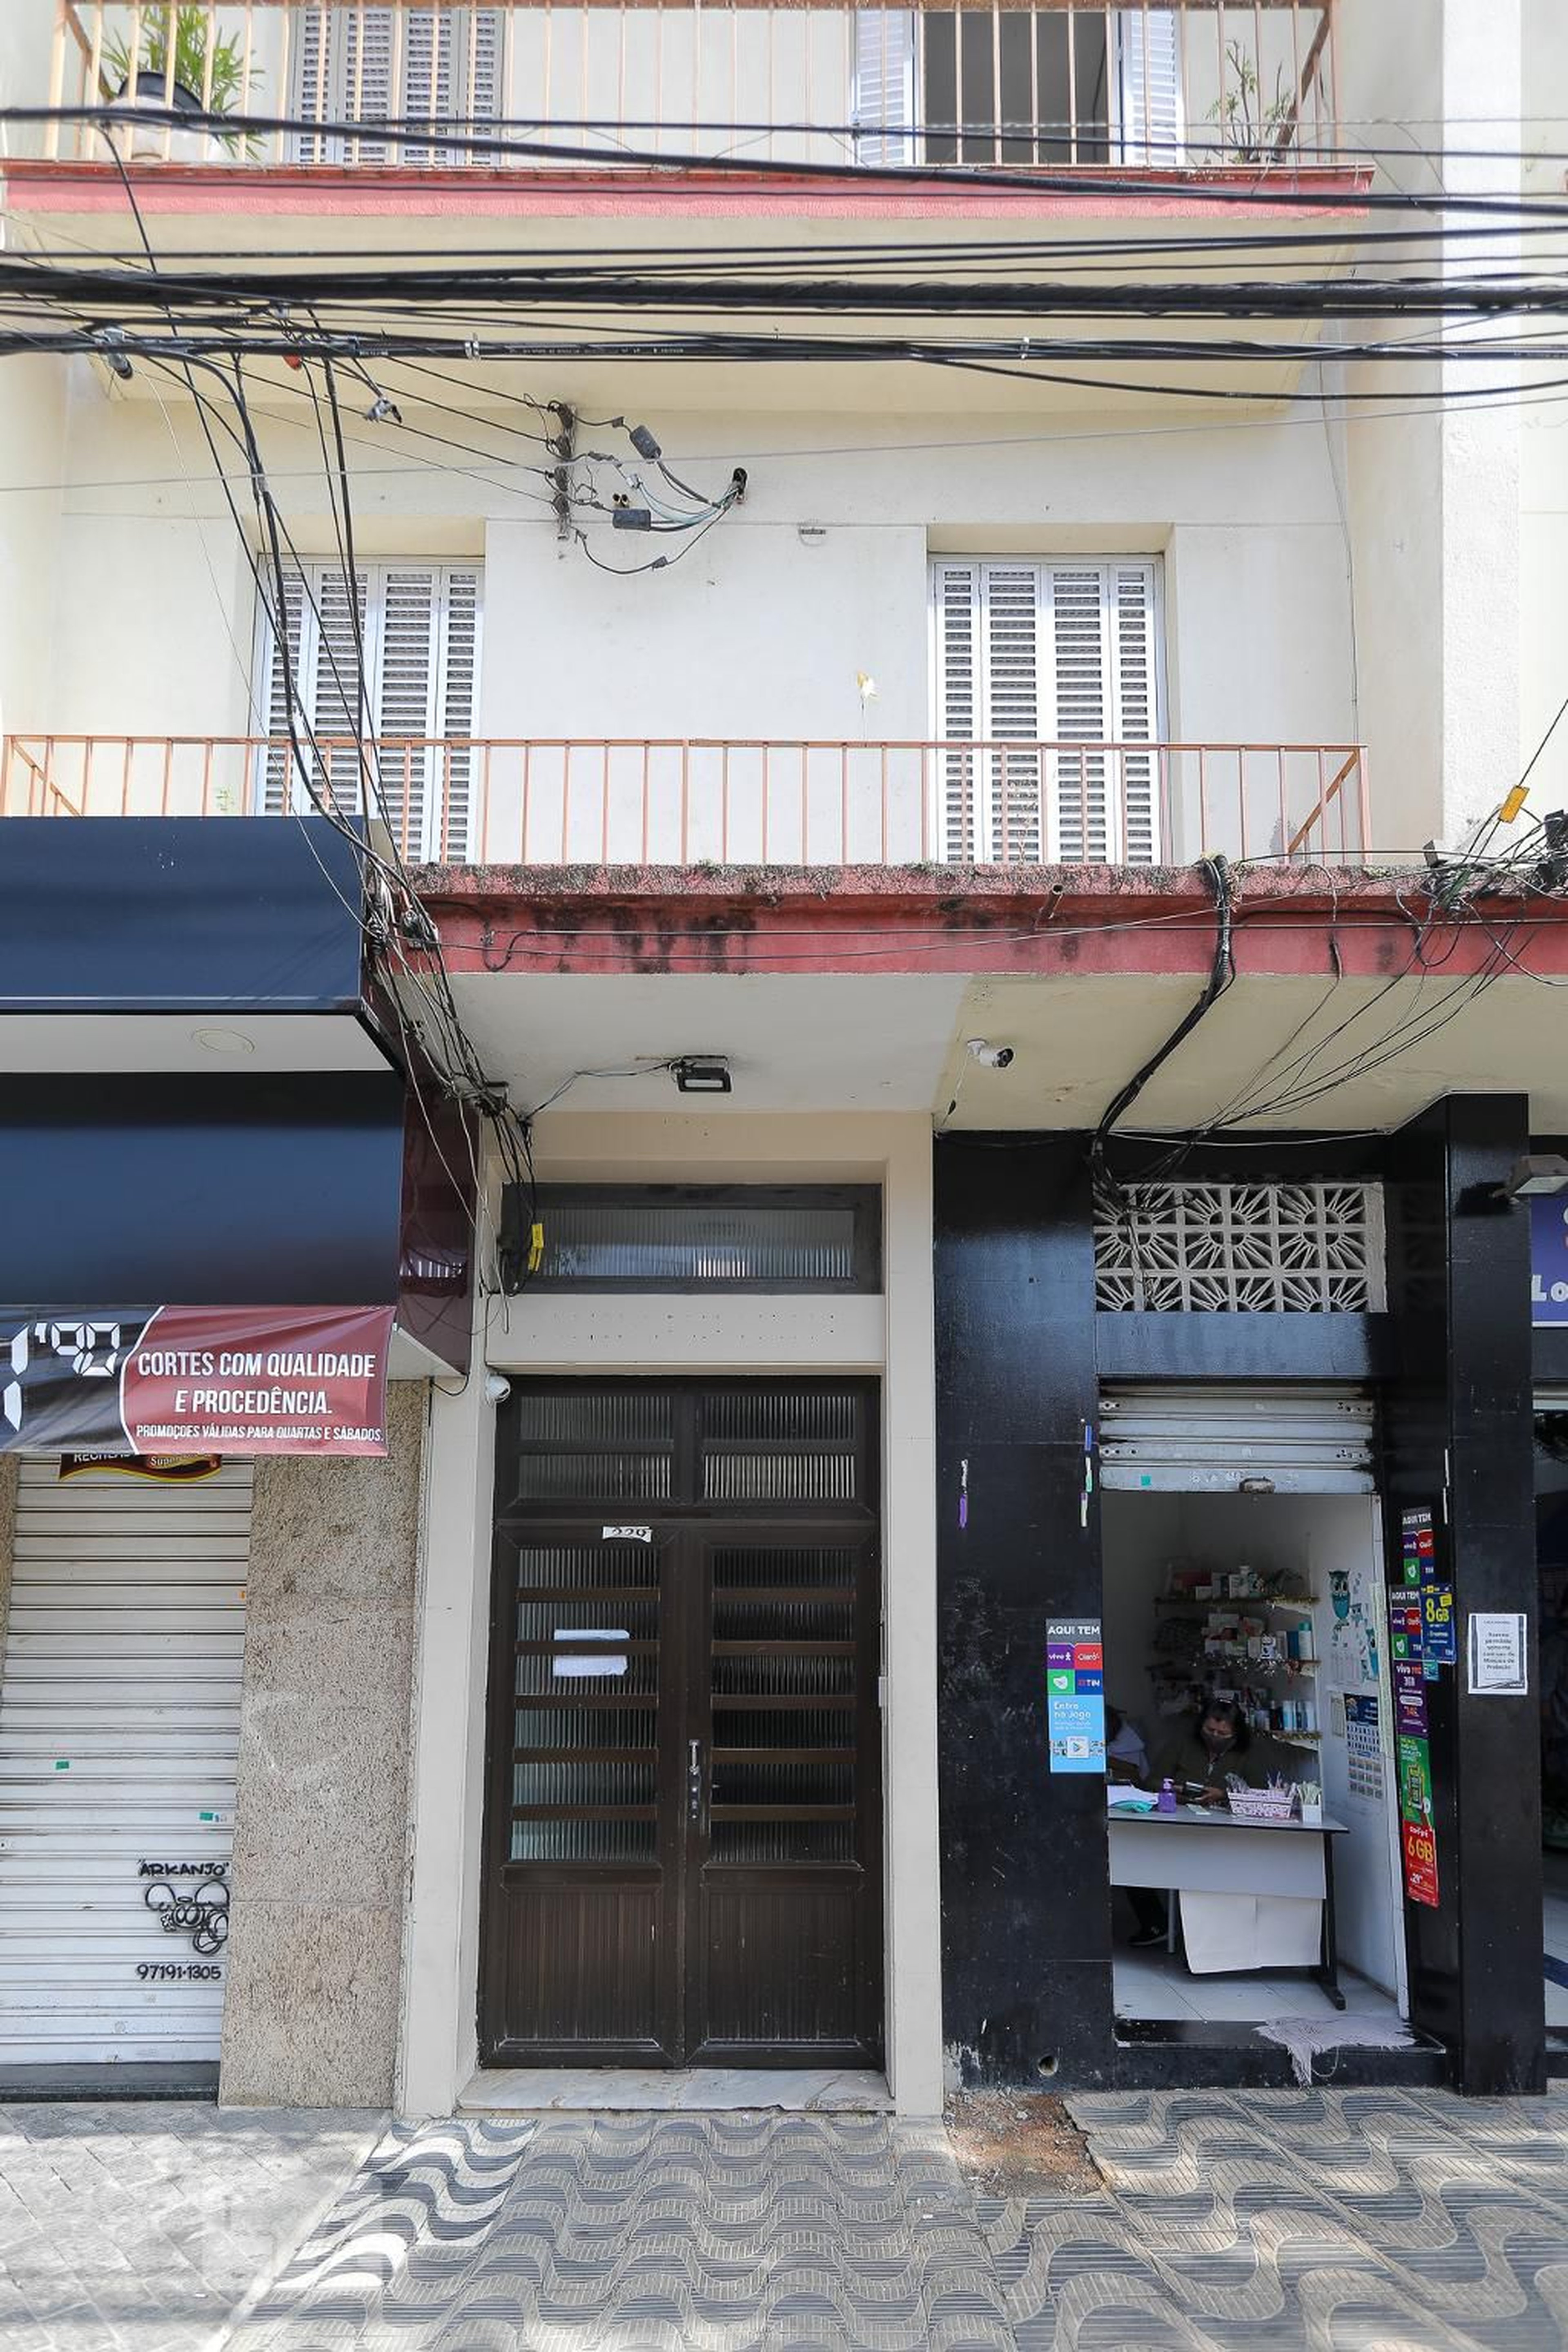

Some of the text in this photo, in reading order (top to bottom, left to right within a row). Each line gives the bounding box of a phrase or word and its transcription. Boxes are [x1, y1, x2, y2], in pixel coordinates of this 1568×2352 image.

[138, 1352, 376, 1377] CORTES COM QUALIDADE
[175, 1386, 332, 1414] E PROCEDÊNCIA.
[202, 1423, 245, 1438] VÁLIDAS
[247, 1426, 274, 1439] PARA
[276, 1426, 322, 1439] QUARTAS
[324, 1428, 332, 1440] E
[333, 1425, 384, 1441] SÁBADOS.
[1048, 1626, 1100, 1635] AQUI TEM
